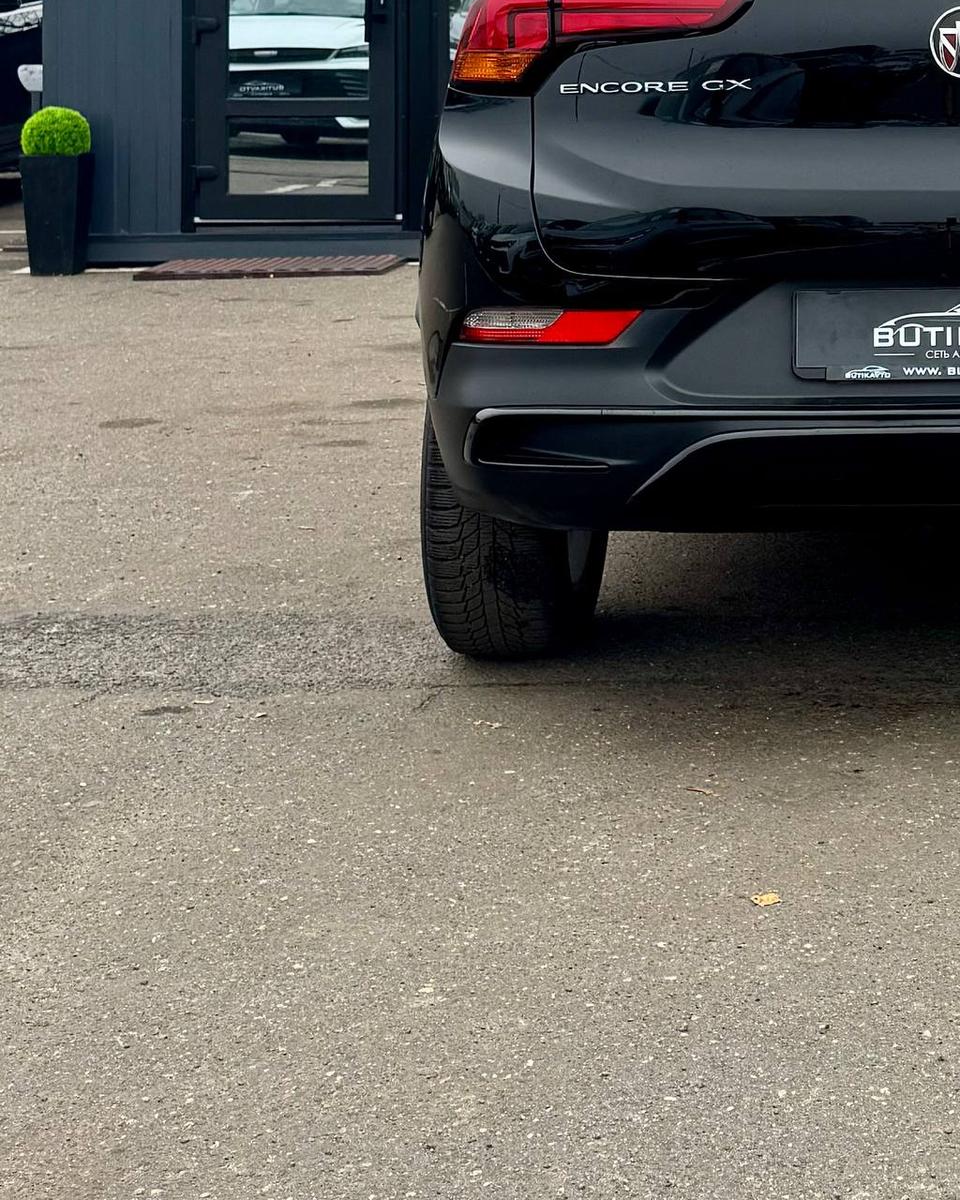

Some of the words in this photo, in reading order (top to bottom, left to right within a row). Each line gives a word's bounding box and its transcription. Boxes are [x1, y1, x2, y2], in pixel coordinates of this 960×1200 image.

[559, 80, 690, 95] ENCORE
[701, 78, 753, 92] GX
[925, 349, 950, 360] СЕТЬ
[903, 367, 942, 376] WWW.
